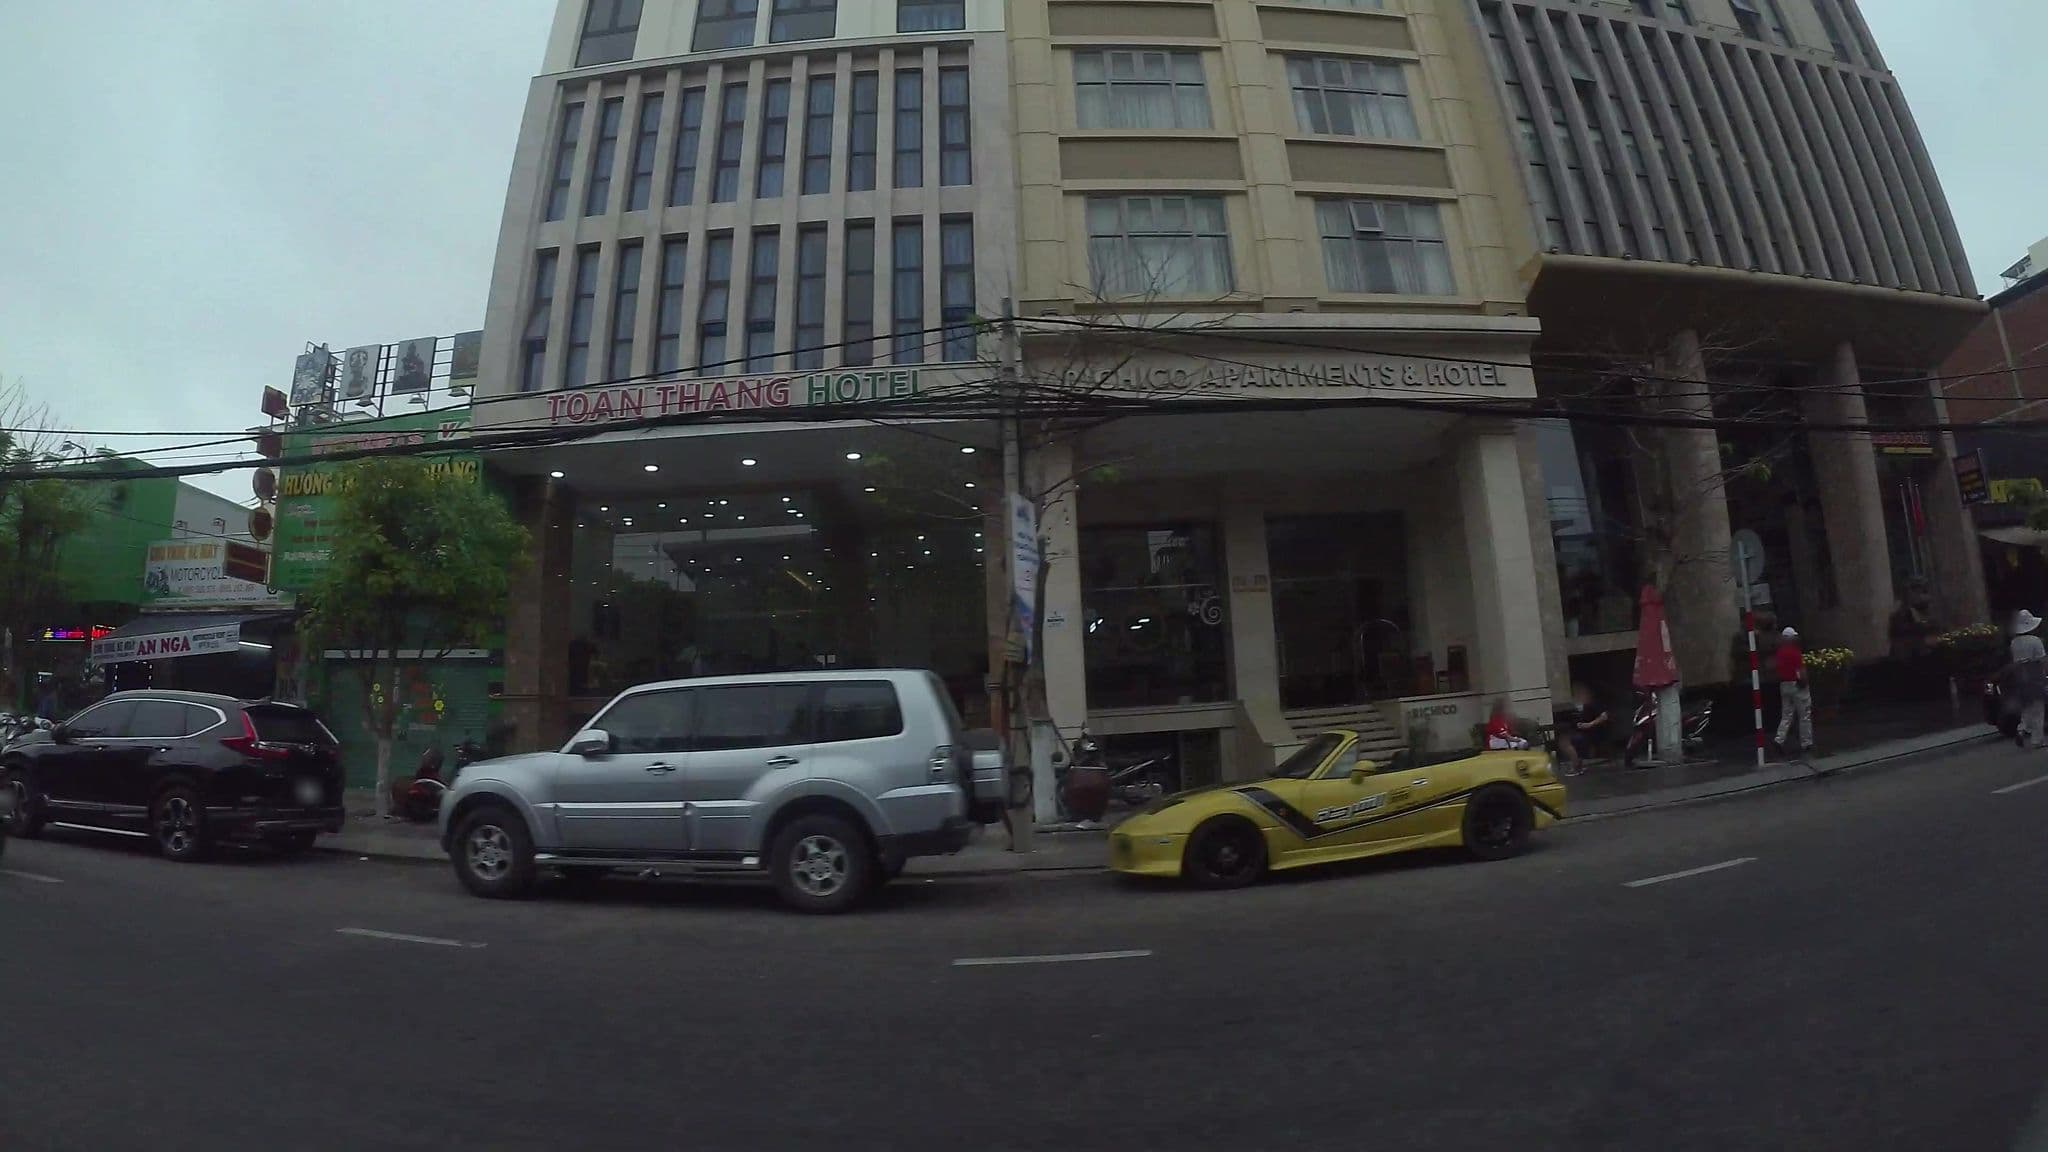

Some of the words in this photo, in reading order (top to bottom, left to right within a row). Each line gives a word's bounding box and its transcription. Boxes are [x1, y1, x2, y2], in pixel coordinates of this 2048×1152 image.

[1200, 364, 1395, 388] APARTMENTS
[1402, 365, 1422, 387] &
[1425, 363, 1506, 387] HOTEL
[548, 388, 645, 423] TOAN
[656, 377, 791, 414] THANG
[806, 370, 922, 406] HOTEL
[167, 566, 229, 581] MOTORCYCL
[136, 638, 157, 656] AN
[160, 635, 191, 653] NGA
